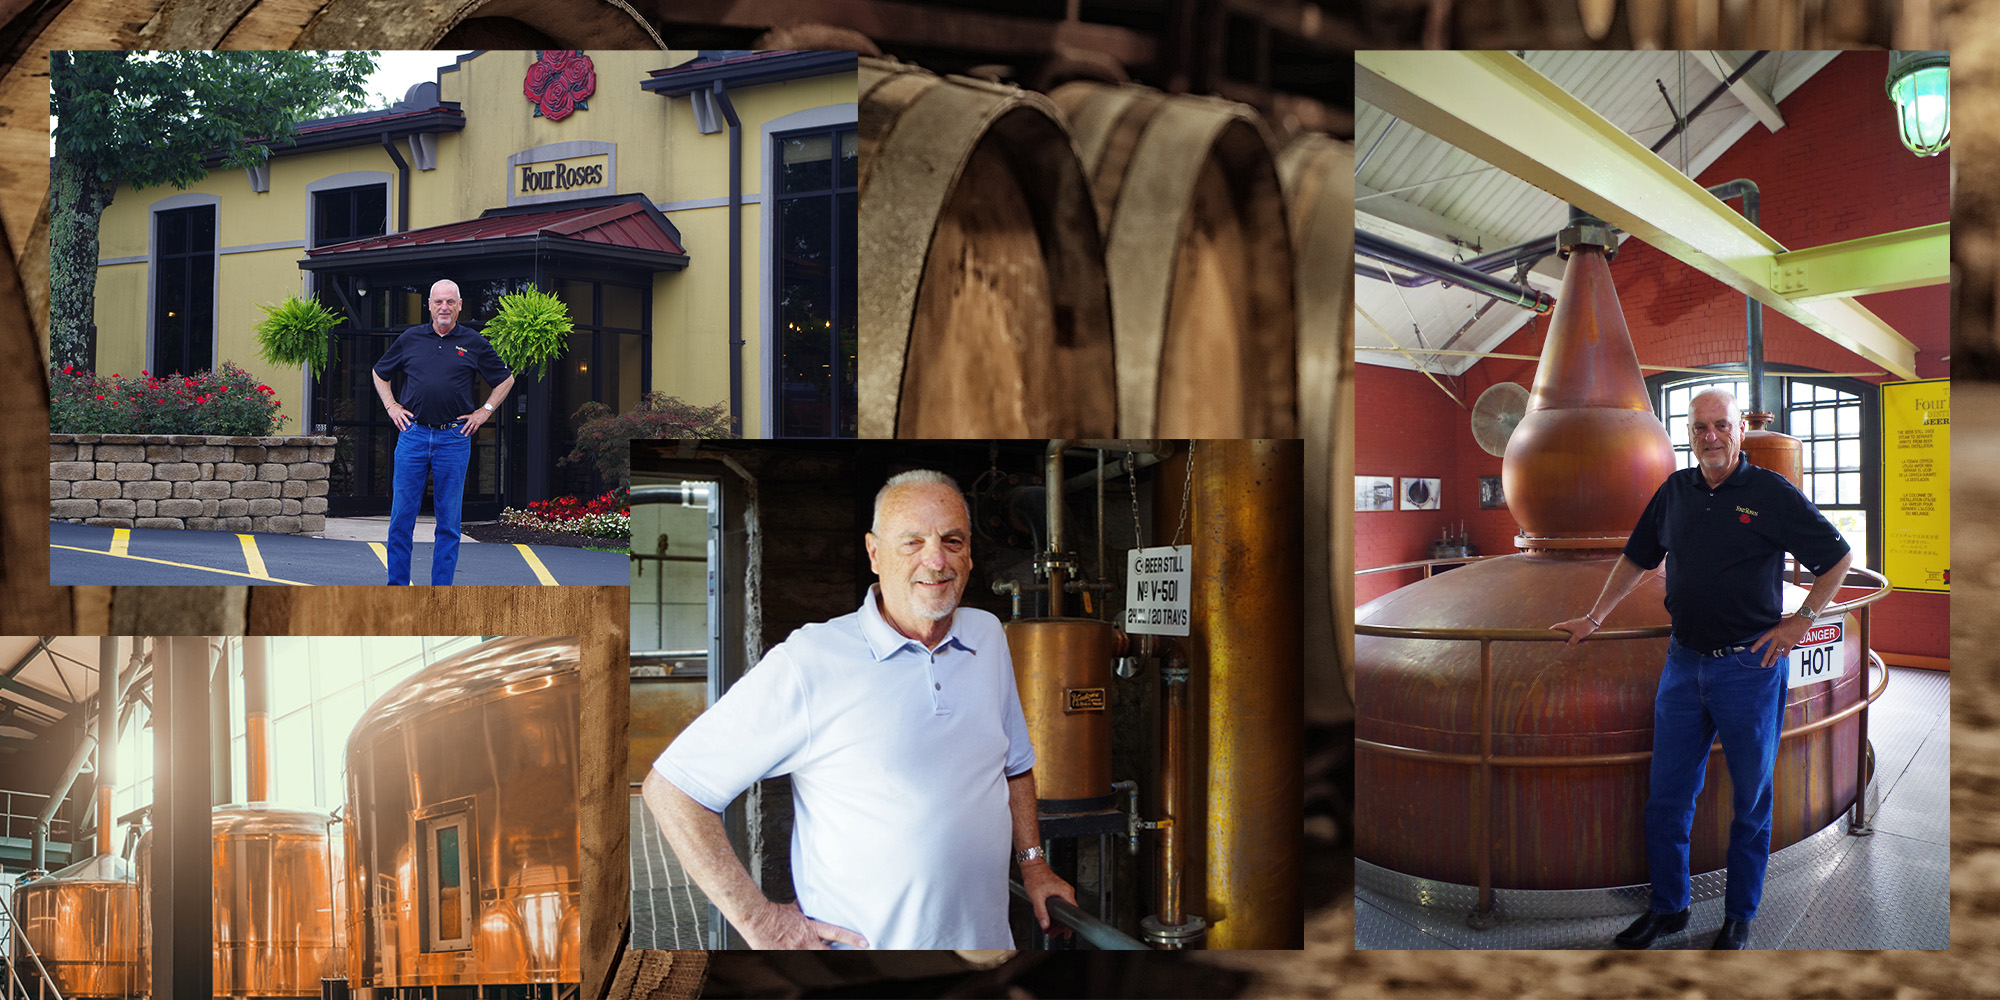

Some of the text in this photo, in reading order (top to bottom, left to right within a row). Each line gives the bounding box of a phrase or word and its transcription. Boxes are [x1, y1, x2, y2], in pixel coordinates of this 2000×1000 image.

[521, 163, 603, 192] Four Roses
[1915, 398, 1946, 411] Four
[1145, 558, 1162, 573] BEER
[1164, 556, 1184, 572] STILL
[1151, 580, 1178, 602] V-501
[1152, 609, 1162, 624] 20
[1163, 609, 1187, 626] TRAYS
[1800, 628, 1835, 644] DANGER
[1801, 646, 1833, 677] HOT
